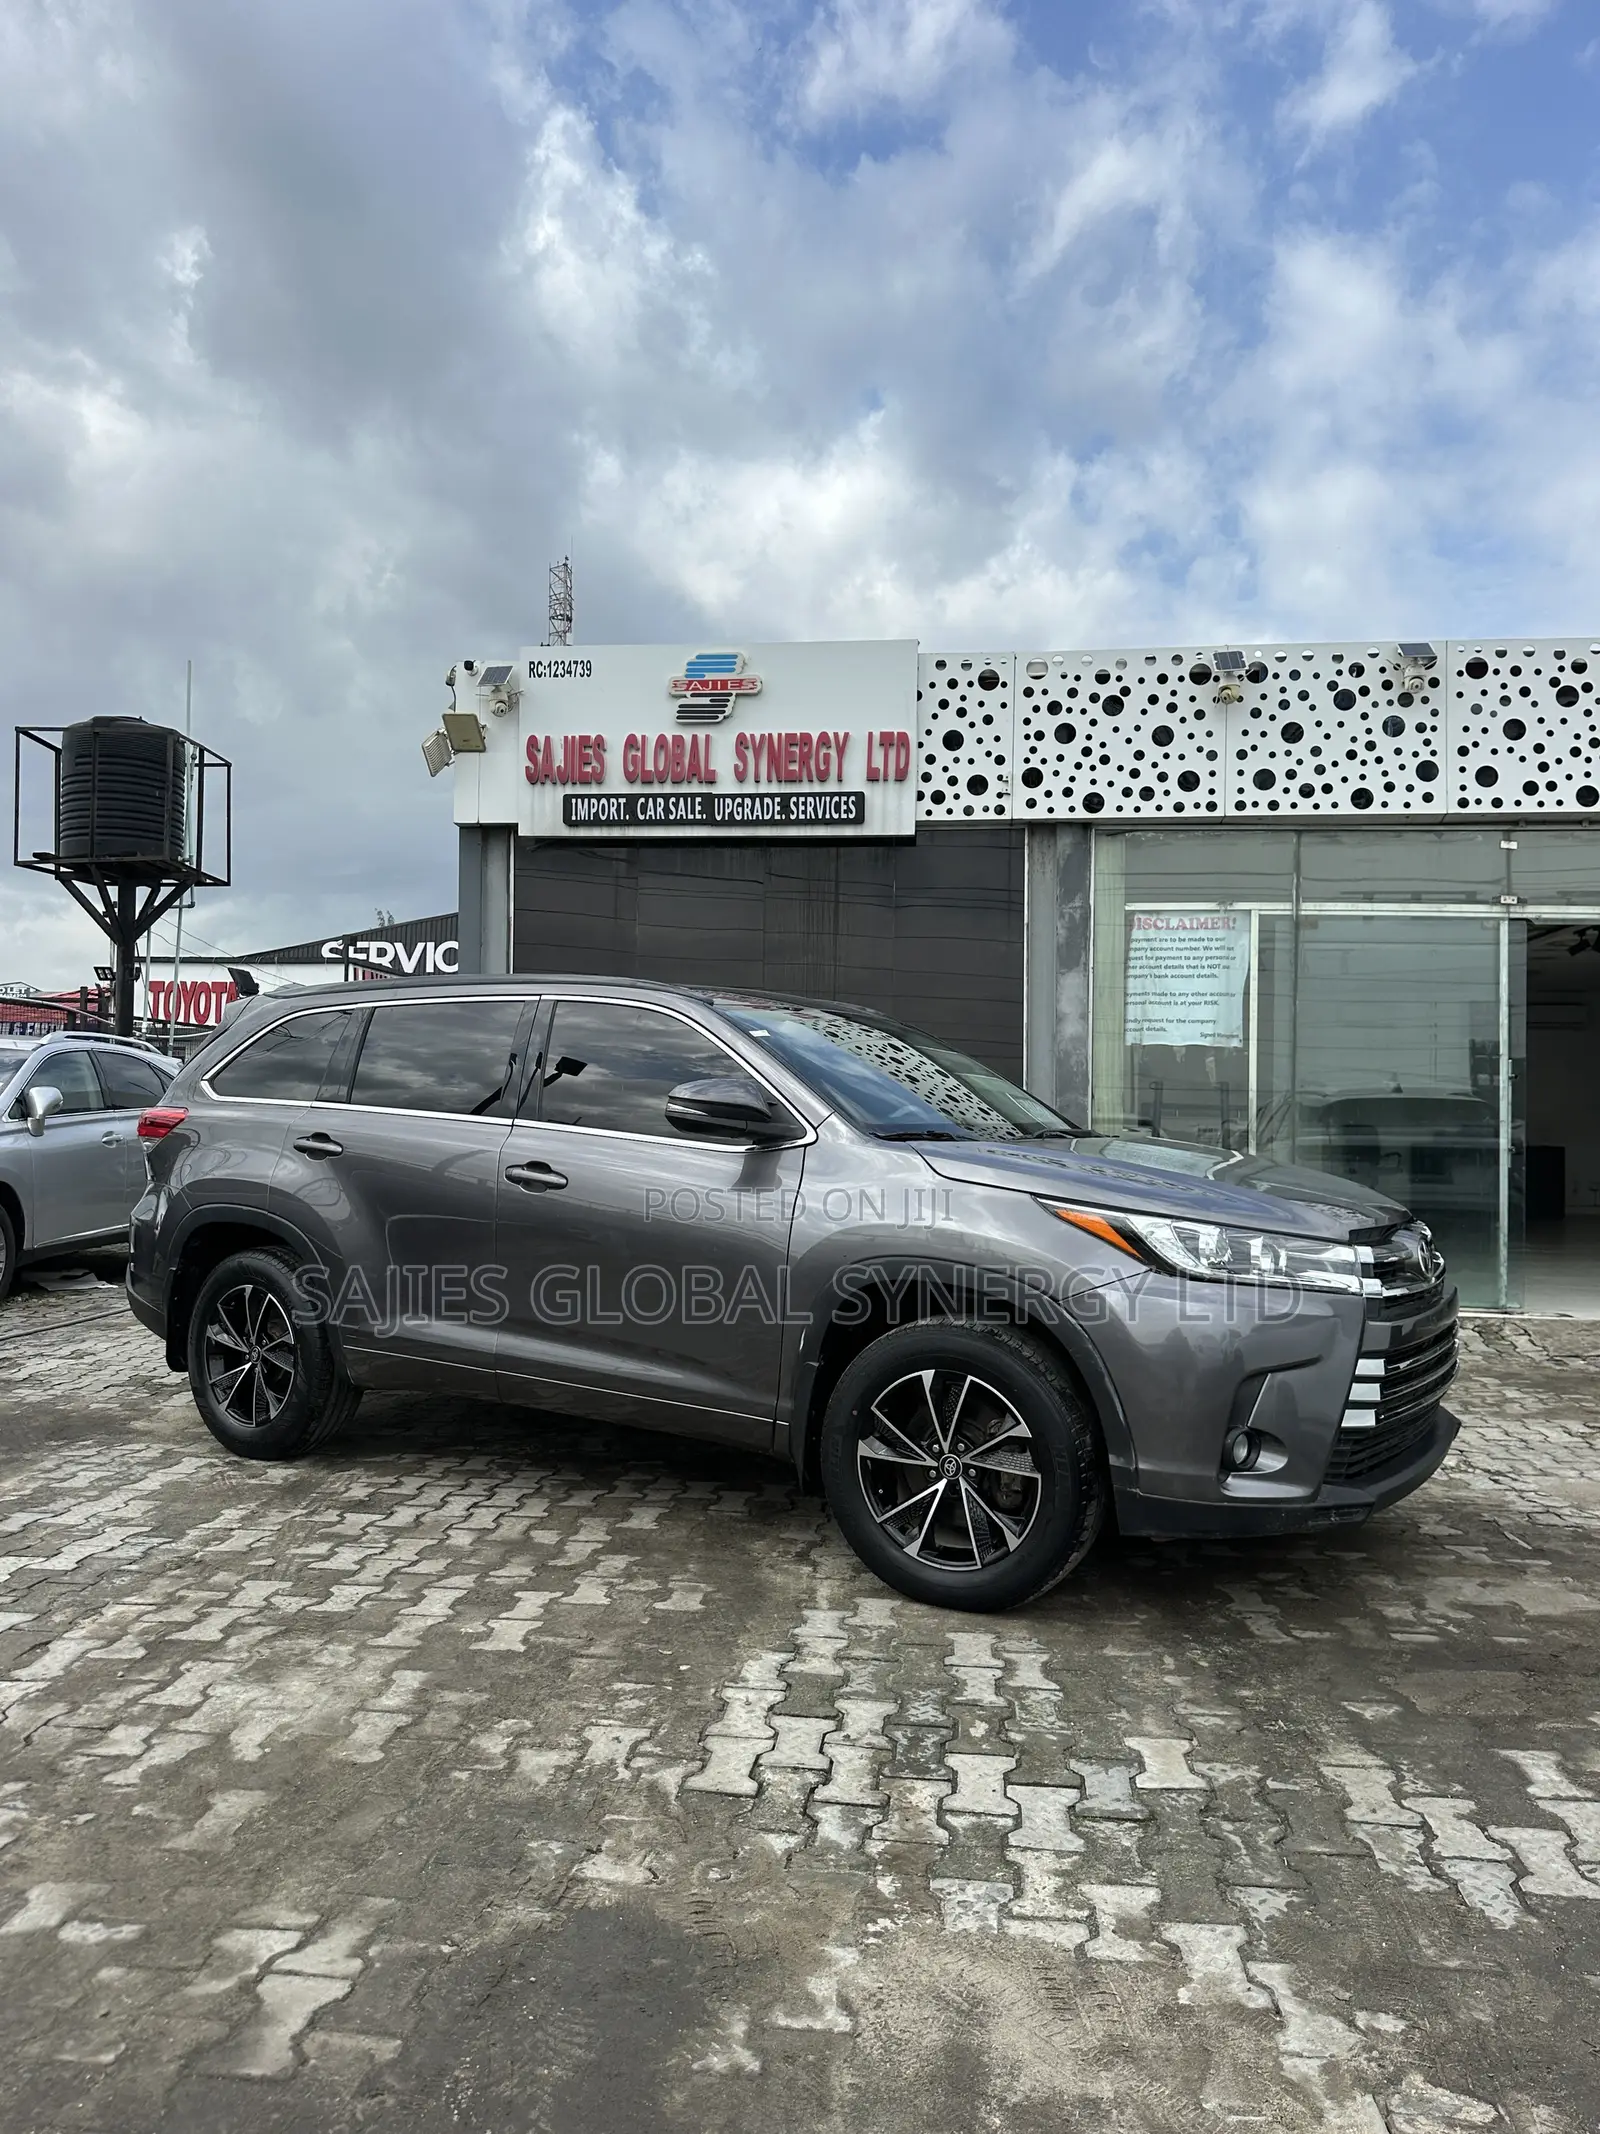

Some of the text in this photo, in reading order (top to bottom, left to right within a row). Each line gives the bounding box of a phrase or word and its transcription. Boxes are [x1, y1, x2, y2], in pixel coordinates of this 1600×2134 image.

[528, 660, 592, 678] RC:1234739
[671, 679, 758, 691] SAJIES
[525, 731, 911, 784] SAJIES GLOBAL SYNERGY LTD
[571, 795, 856, 820] IMPORT. CAR SALE. UPGRADE. SERVICES
[149, 980, 237, 1025] TOYOTA
